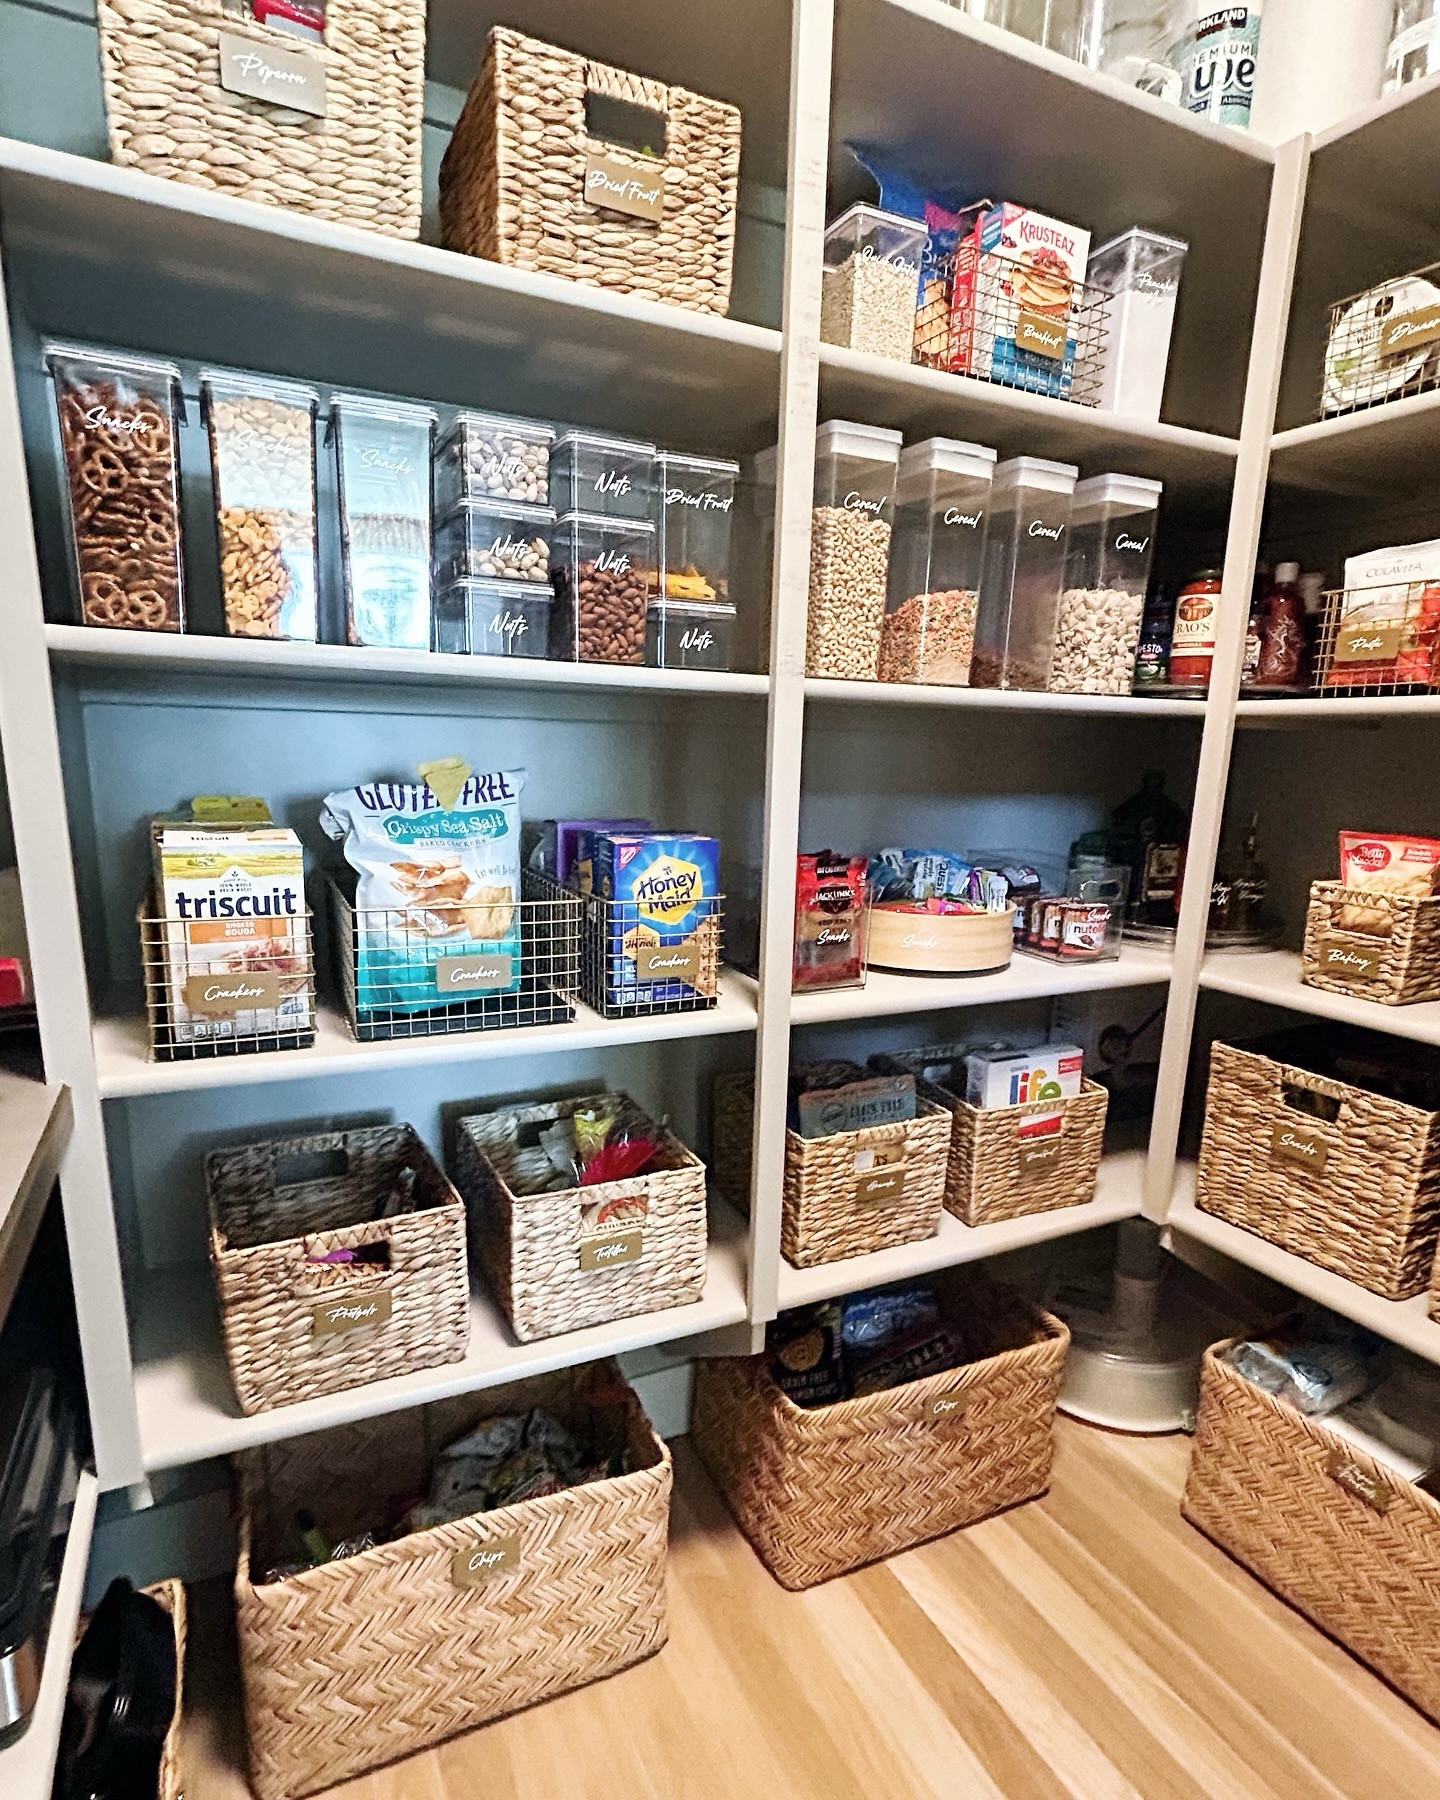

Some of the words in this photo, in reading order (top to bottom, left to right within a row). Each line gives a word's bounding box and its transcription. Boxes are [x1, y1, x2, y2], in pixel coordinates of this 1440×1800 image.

[231, 53, 307, 85] Popcorn
[587, 170, 630, 198] Dried
[629, 181, 661, 206] Fruit
[1020, 220, 1075, 257] KRUSTEAZ
[1023, 324, 1063, 349] Breakfast
[85, 406, 153, 434] Snacks
[235, 430, 296, 454] Snacks
[360, 449, 415, 475] Snacks
[485, 454, 525, 482] Nuts
[594, 471, 632, 498] Nuts
[664, 488, 704, 508] Dried
[704, 493, 734, 513] Fruit
[843, 491, 887, 515] Cereal
[944, 507, 983, 529] Cereal
[1028, 520, 1065, 541] Cereal
[490, 534, 529, 564] Nuts
[1115, 533, 1150, 553] Cereal
[594, 550, 631, 576] Nuts
[1366, 562, 1424, 578] COLAVITA
[489, 611, 529, 638] Nuts
[1176, 622, 1210, 634] RAO'S
[679, 628, 714, 652] Nuts
[1348, 636, 1384, 652] Pasta
[355, 779, 442, 812] GLUTE
[387, 820, 440, 838] Crispy
[440, 818, 469, 834] Sea
[469, 812, 504, 831] Salt
[419, 840, 446, 848] BAKED
[637, 871, 697, 900] Honey
[935, 860, 949, 892] QUEST
[175, 888, 297, 919] triscuit
[648, 887, 692, 914] Maid
[225, 921, 255, 929] SMOKED
[1087, 908, 1112, 922] Snacks
[225, 928, 256, 937] GOUDA
[816, 928, 851, 946] Snacks
[900, 933, 940, 949] Snacks
[649, 954, 691, 970] Crackers
[1328, 949, 1373, 971] Baking
[450, 966, 501, 983] Crackers
[204, 983, 265, 1001] Crackers
[1010, 1068, 1062, 1105] life
[1279, 1133, 1318, 1156] Snacks
[325, 1302, 379, 1323] Pretzels
[933, 1400, 958, 1414] Chips
[468, 1551, 506, 1571] Chips
